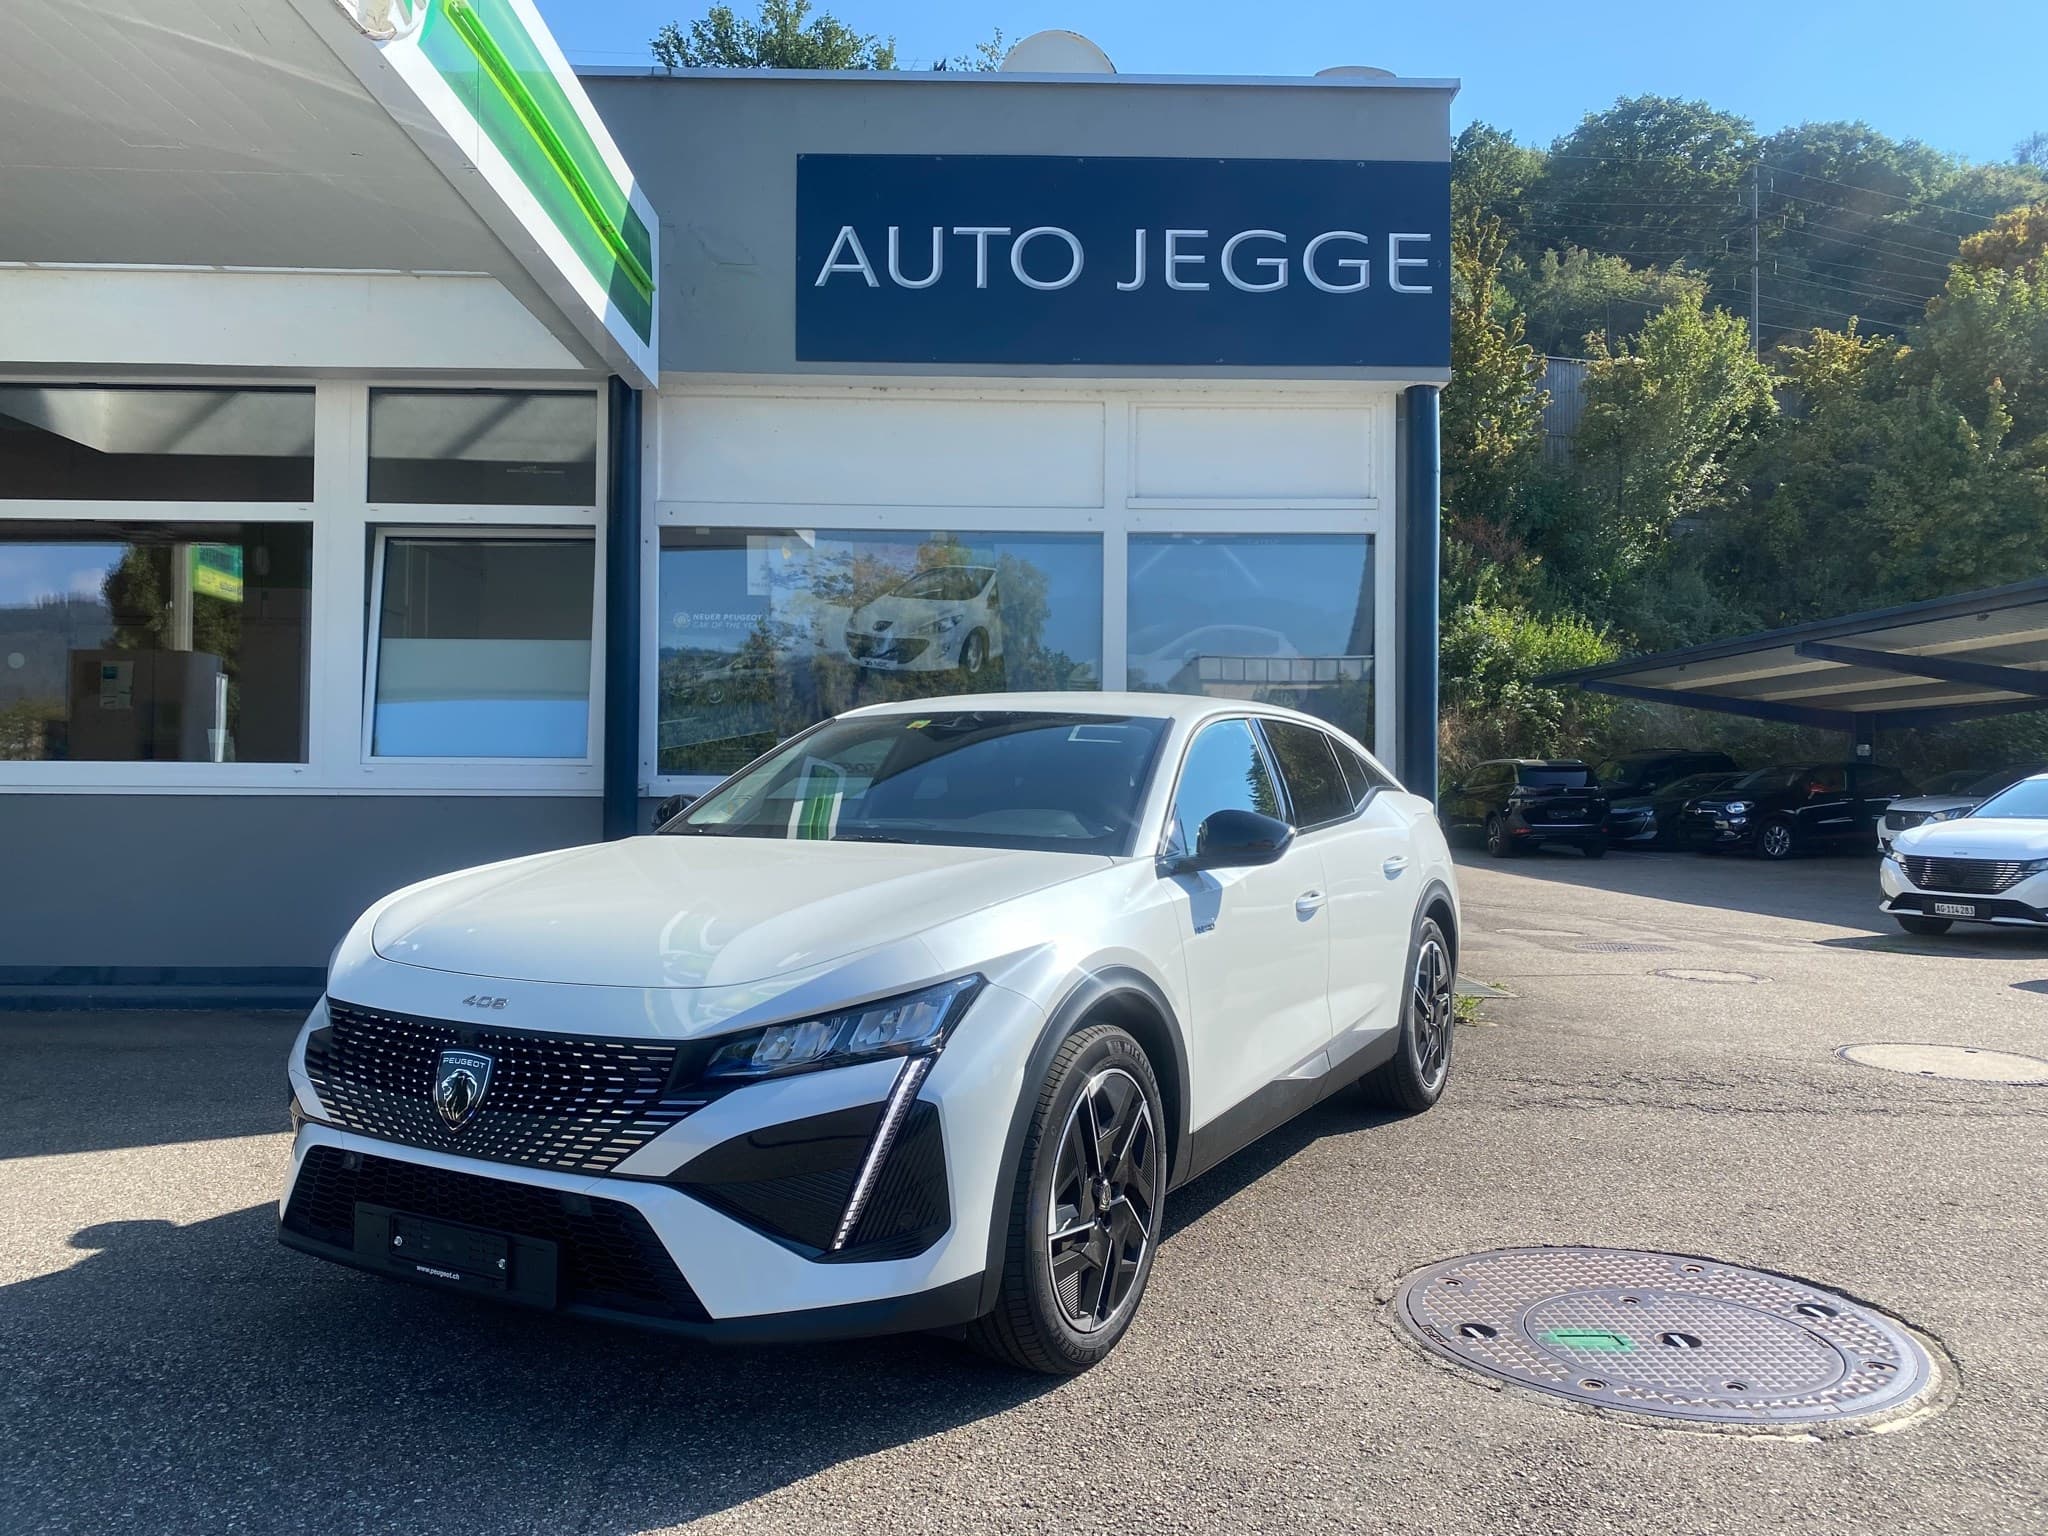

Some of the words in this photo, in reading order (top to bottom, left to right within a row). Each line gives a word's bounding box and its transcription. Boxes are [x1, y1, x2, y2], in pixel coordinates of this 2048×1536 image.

[814, 225, 1085, 291] AUTO
[1116, 228, 1433, 294] JEGGE
[723, 613, 763, 621] PEUGEOT
[462, 994, 510, 1010] 408
[442, 1057, 486, 1069] PEUGEOT
